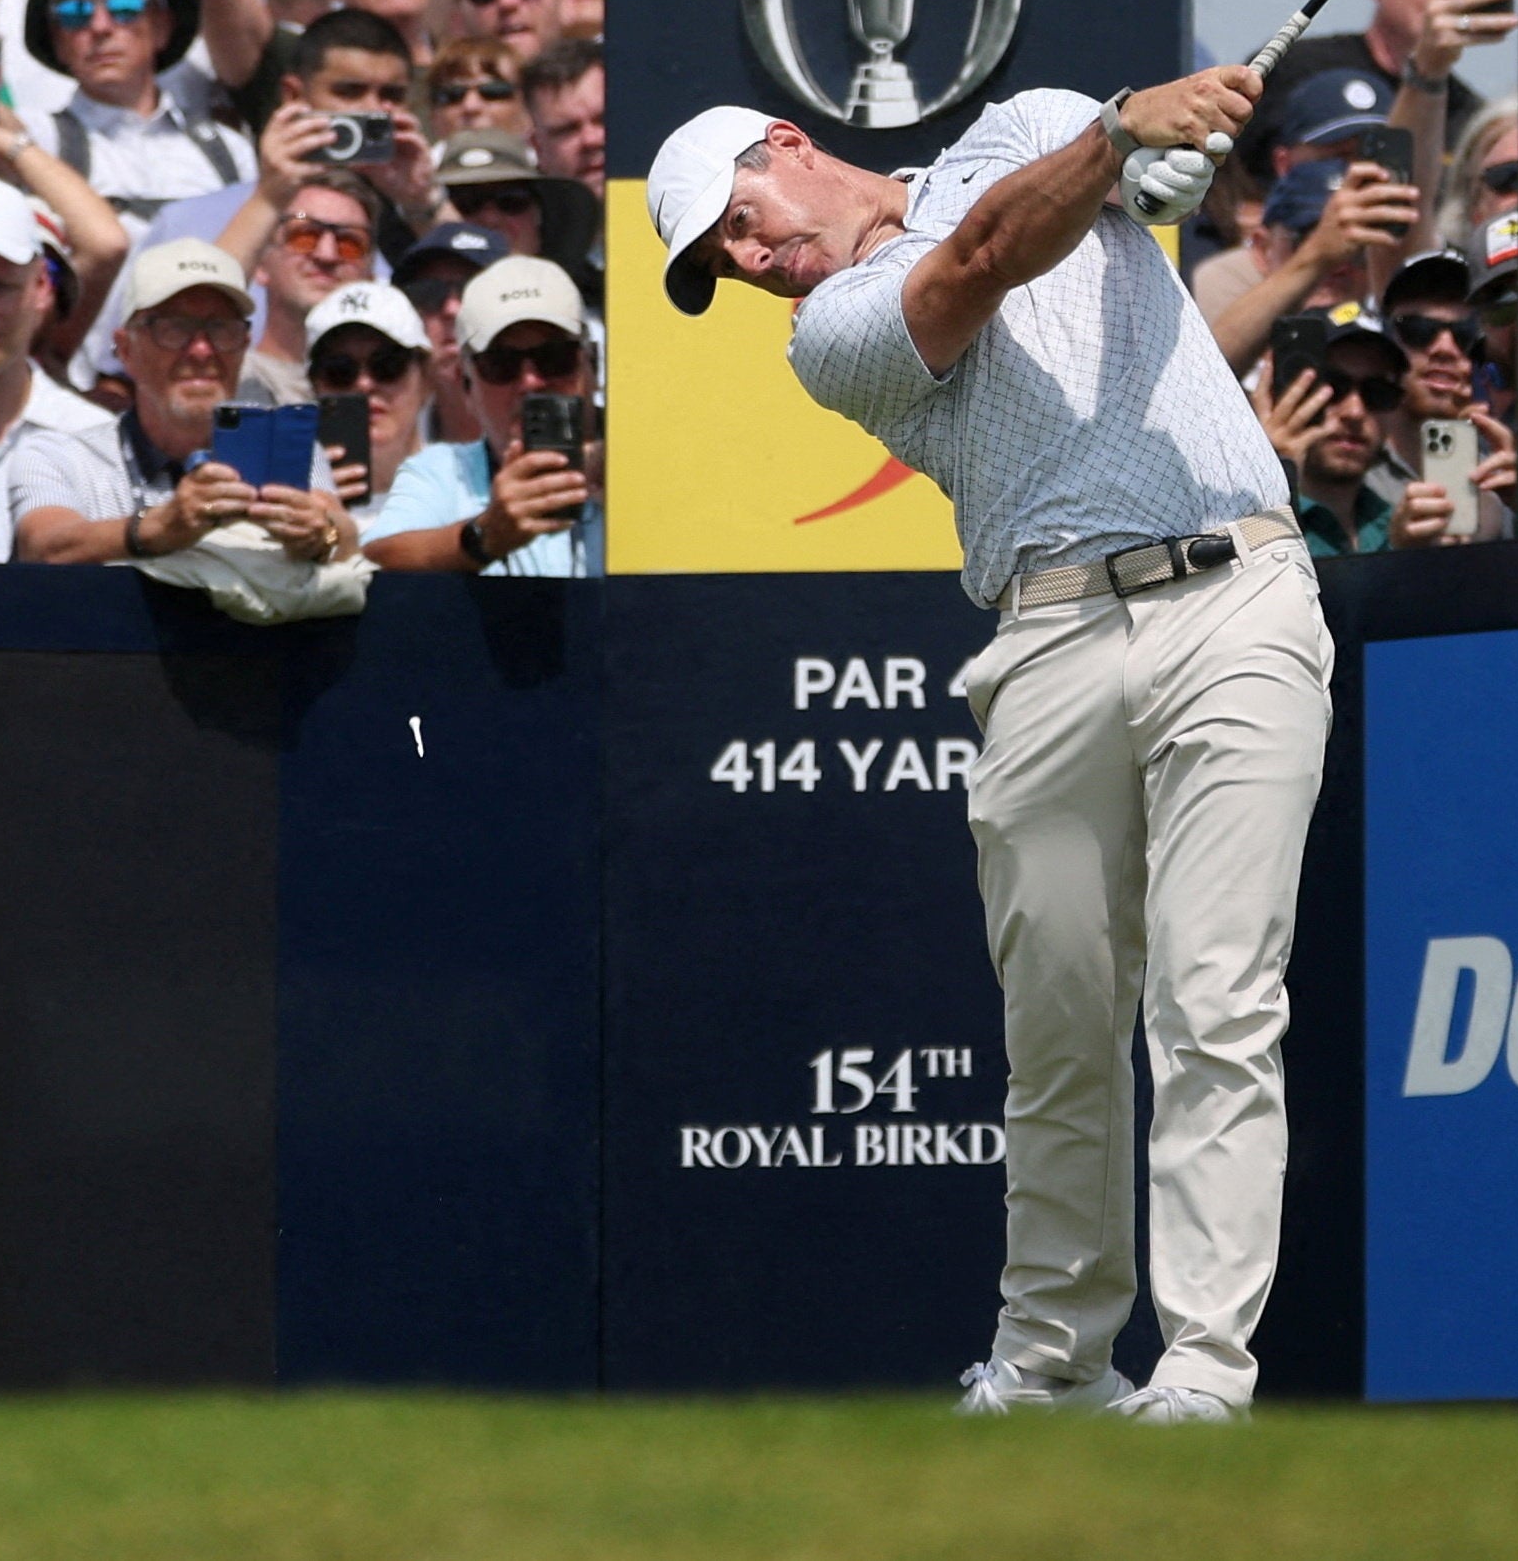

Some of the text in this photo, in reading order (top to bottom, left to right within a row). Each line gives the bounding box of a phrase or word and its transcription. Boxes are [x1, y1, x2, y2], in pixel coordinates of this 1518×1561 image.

[794, 657, 926, 710] PAR
[710, 739, 980, 792] 414 YAR
[681, 1124, 1006, 1169] ROYAL BIRKD
